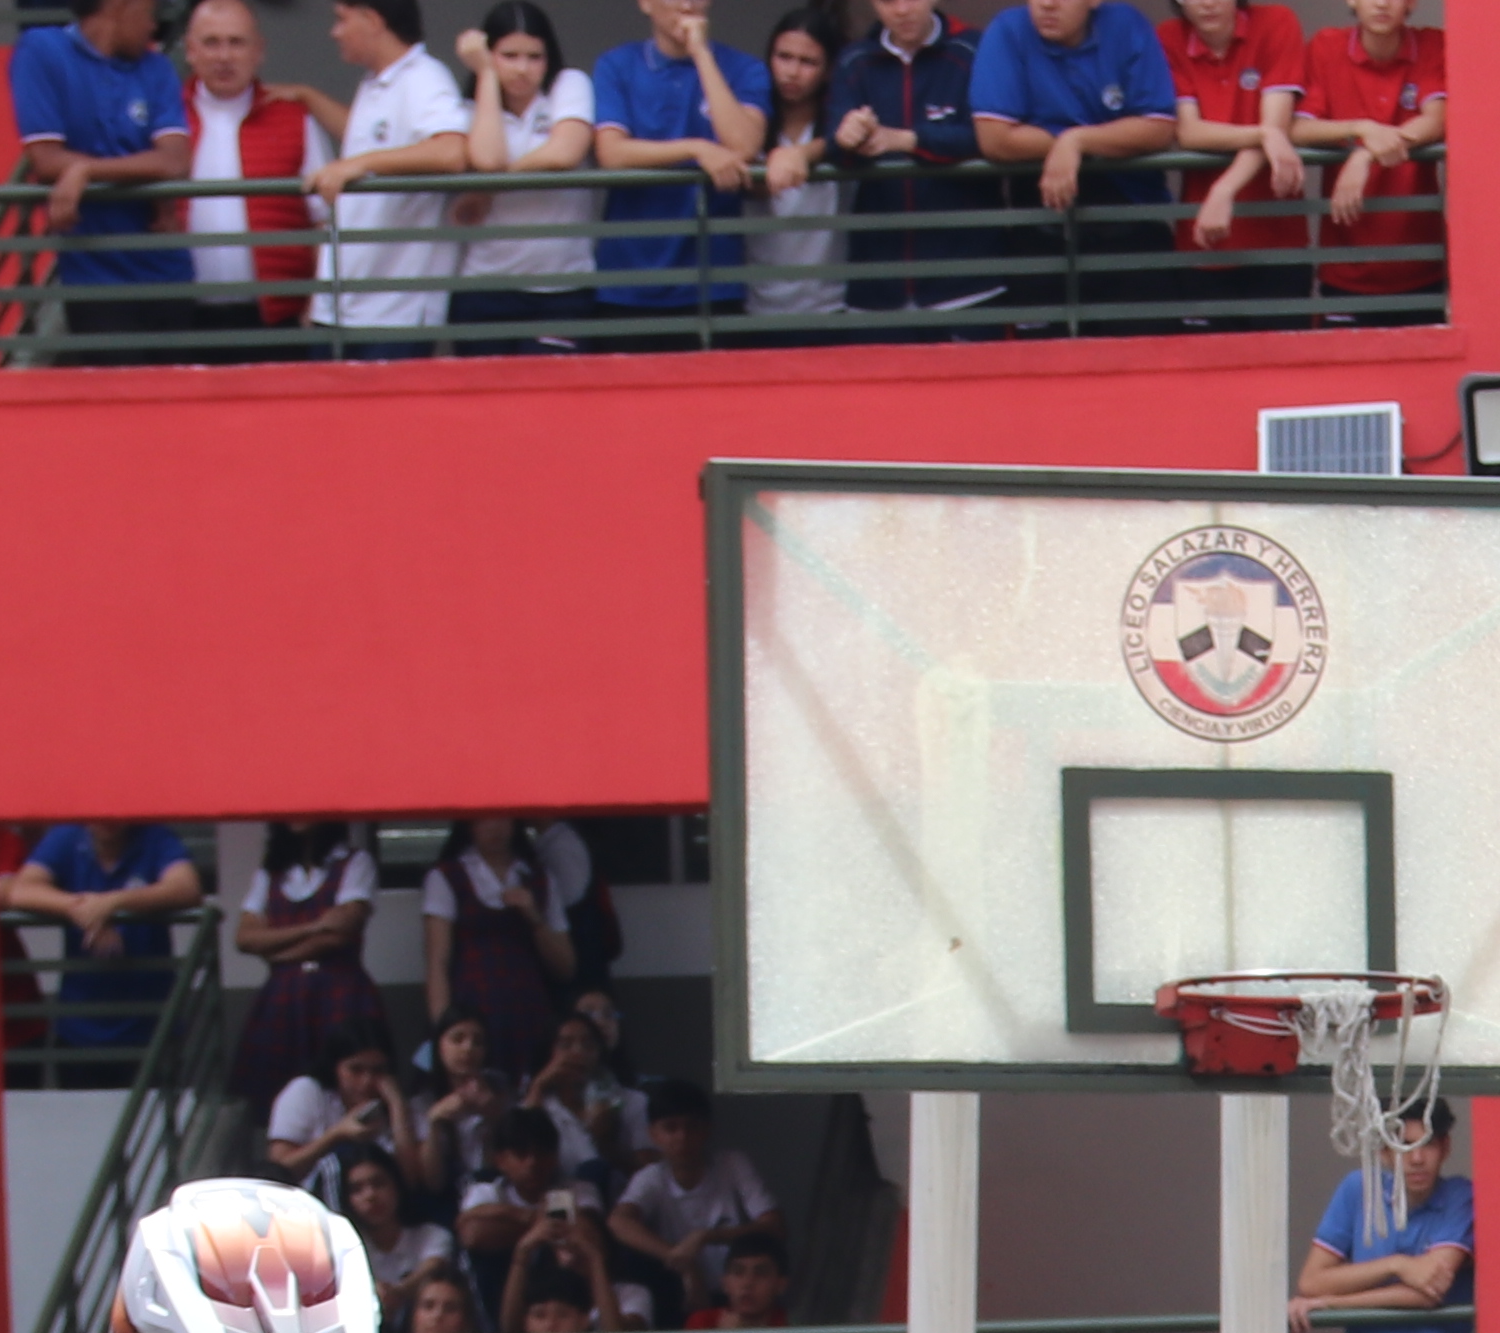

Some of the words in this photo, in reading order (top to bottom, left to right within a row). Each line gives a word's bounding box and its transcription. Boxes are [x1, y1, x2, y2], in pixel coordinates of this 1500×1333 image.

[1125, 595, 1149, 673] LICEO
[1140, 531, 1248, 589] SALAZAR
[1257, 539, 1273, 557] Y
[1273, 556, 1323, 676] HERRERA
[1157, 698, 1219, 735] CIENCIA
[1221, 720, 1236, 735] Y
[1238, 700, 1293, 734] VIRTUD
